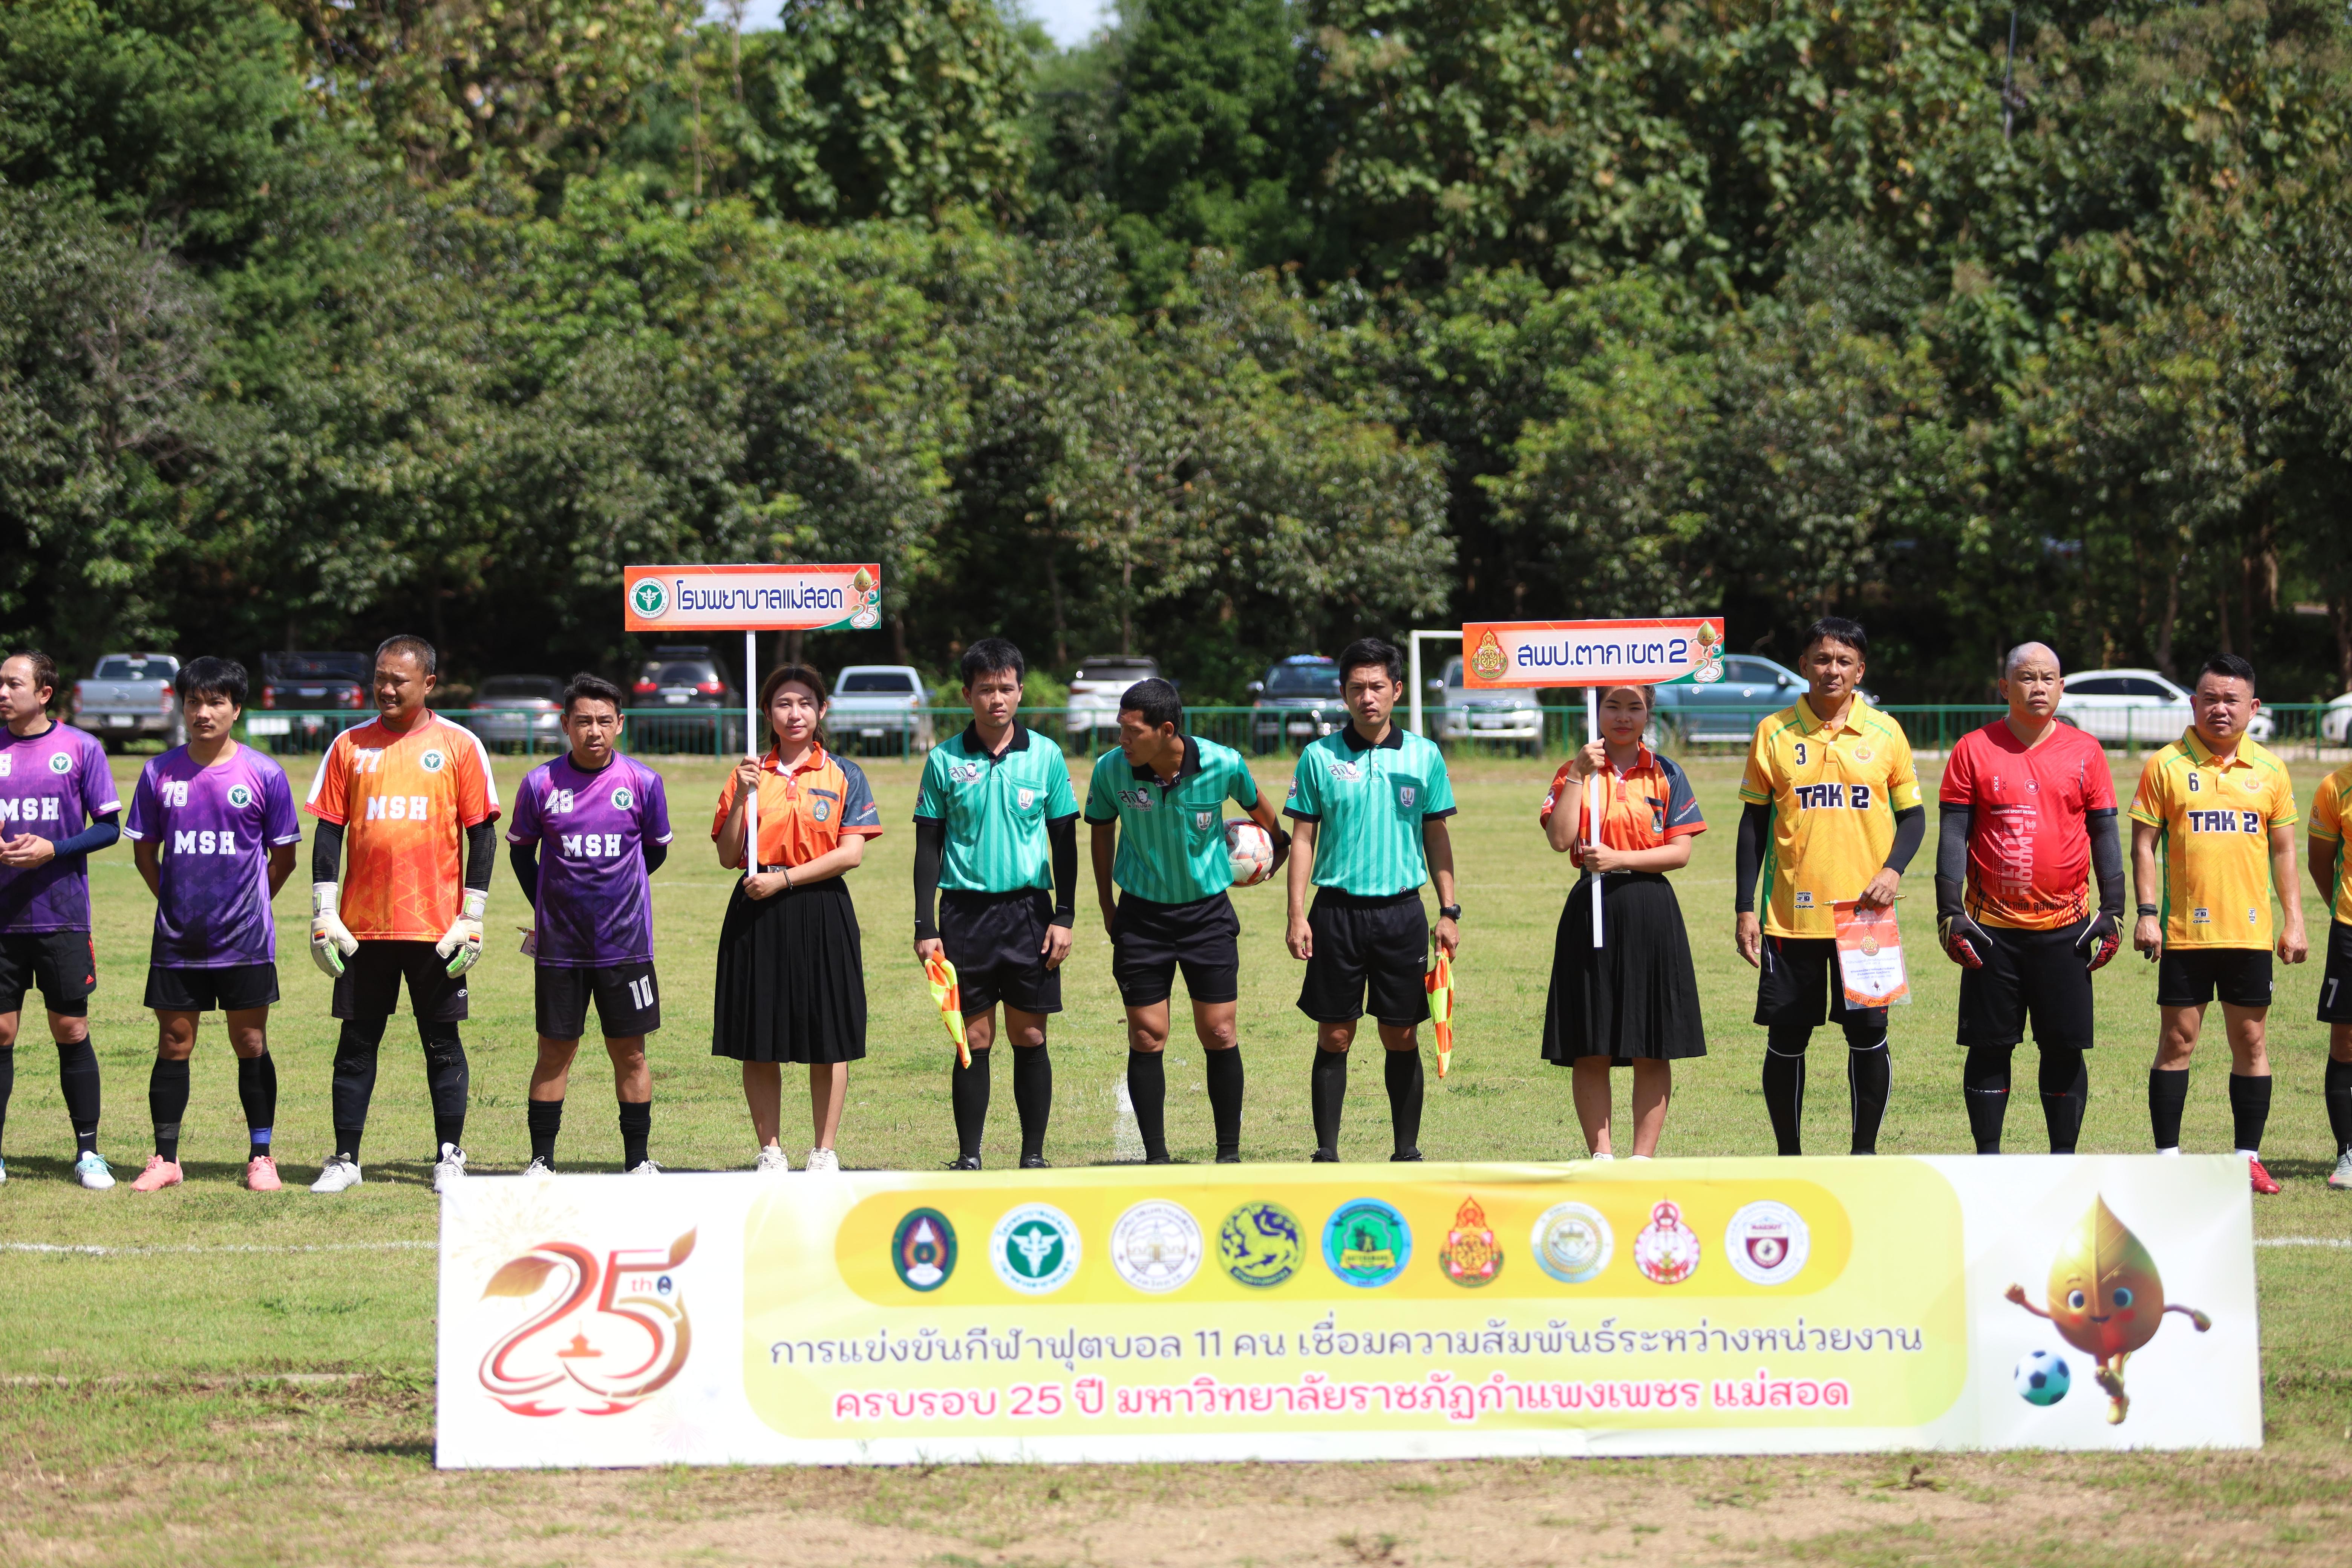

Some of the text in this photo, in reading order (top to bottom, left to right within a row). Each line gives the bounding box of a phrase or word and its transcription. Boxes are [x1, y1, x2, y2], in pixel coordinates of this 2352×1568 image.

[677, 580, 842, 610] โรงพยาบาลแม่สอด
[1518, 639, 1687, 666] สพป.ตาก เขต 2
[355, 749, 383, 773] 77
[1795, 743, 1806, 765] 3
[162, 781, 188, 807] 79
[2188, 773, 2199, 792] 6
[367, 796, 428, 820] MSH
[545, 789, 574, 814] 49
[1795, 784, 1870, 809] TAK 2
[0, 798, 59, 822] MSH
[2188, 812, 2258, 833] TAK 2
[175, 830, 236, 854] MSH
[562, 834, 622, 857] MSH
[629, 975, 654, 1010] 10
[2327, 978, 2339, 1008] 7
[631, 1277, 652, 1292] th
[479, 1225, 697, 1399] 25
[771, 1312, 1922, 1372] การแข่งขันกีฬาฟุตบอล 11 คน เชื่อมความสัมพันธ์ระหว่างหน่วยงาน
[837, 1371, 1849, 1419] ครบรอบ 25 ปี มหาวิทยาลัยราชภัฏกำแพงเพชร แม่สอด
